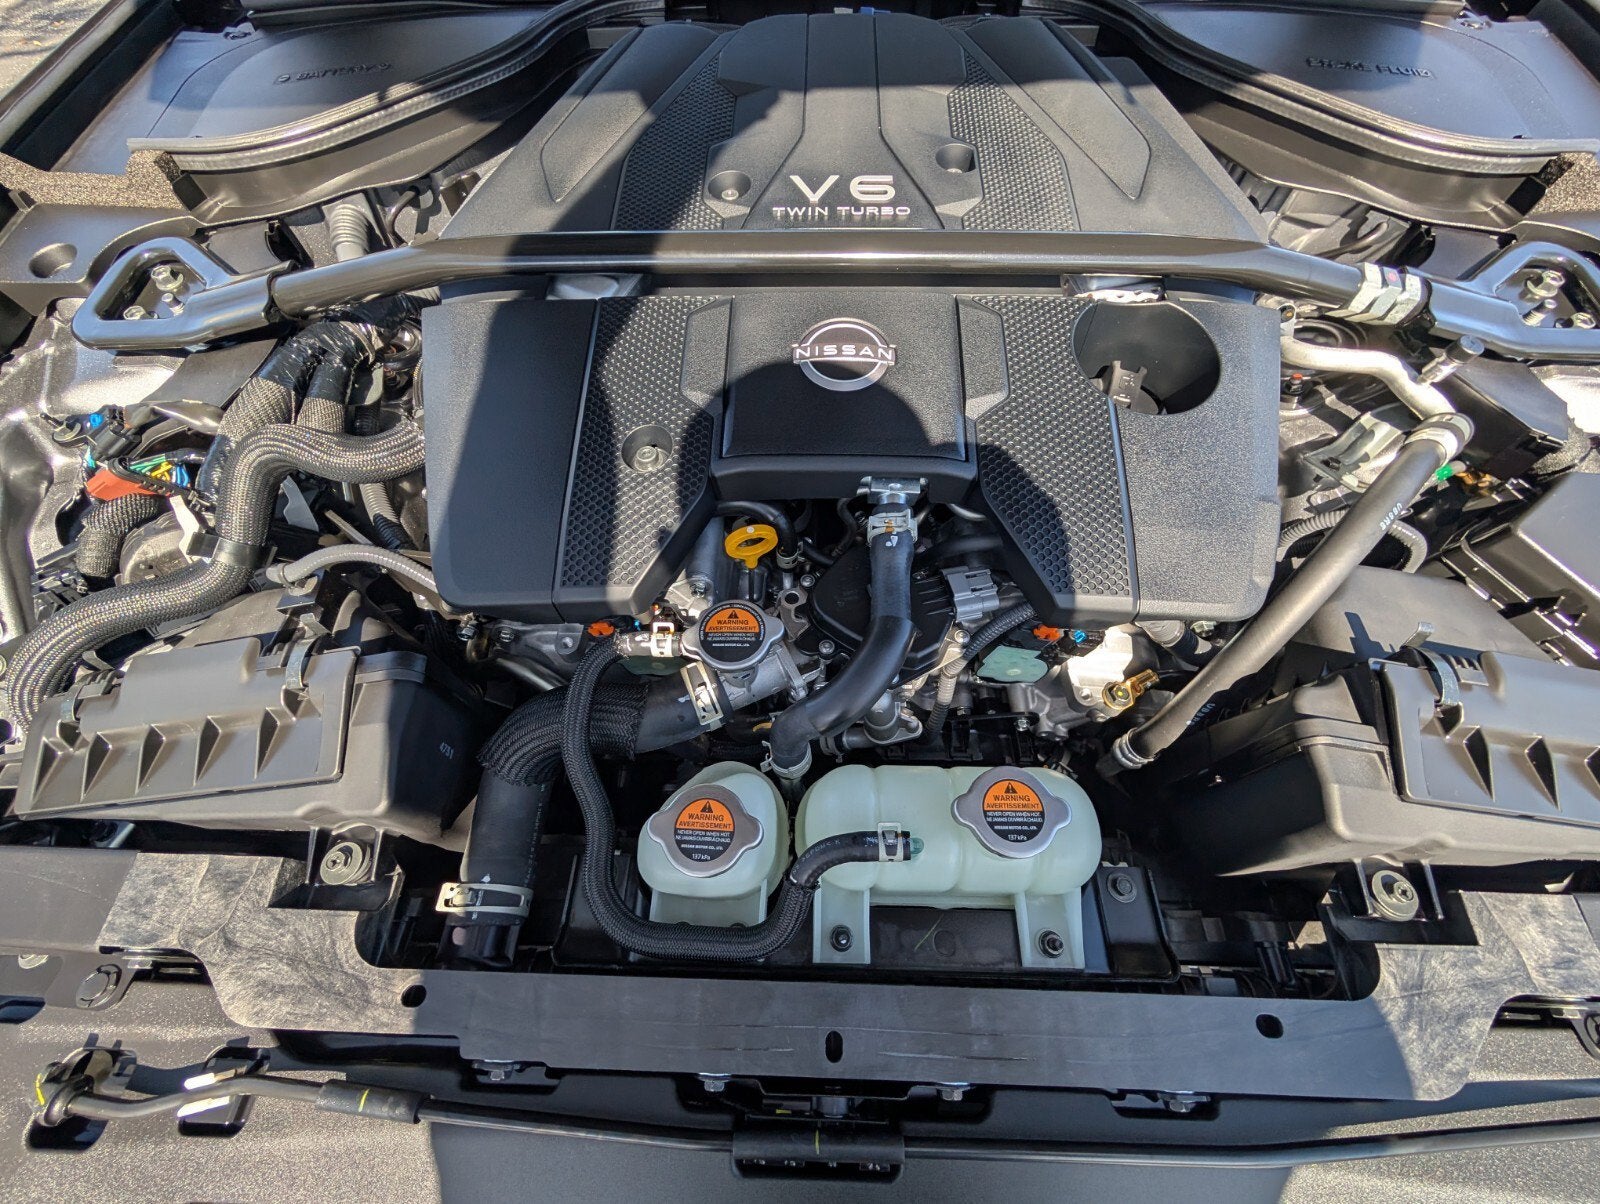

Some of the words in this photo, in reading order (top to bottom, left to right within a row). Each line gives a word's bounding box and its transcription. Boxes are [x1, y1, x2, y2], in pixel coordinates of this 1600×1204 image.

[1375, 64, 1433, 78] FLUID
[772, 206, 829, 217] TWIN
[837, 206, 911, 217] TURBO
[795, 344, 893, 361] NISSAN
[993, 794, 1031, 802] WARNING
[688, 812, 725, 822] WARNING
[678, 820, 732, 830] AVERTISSEMENT
